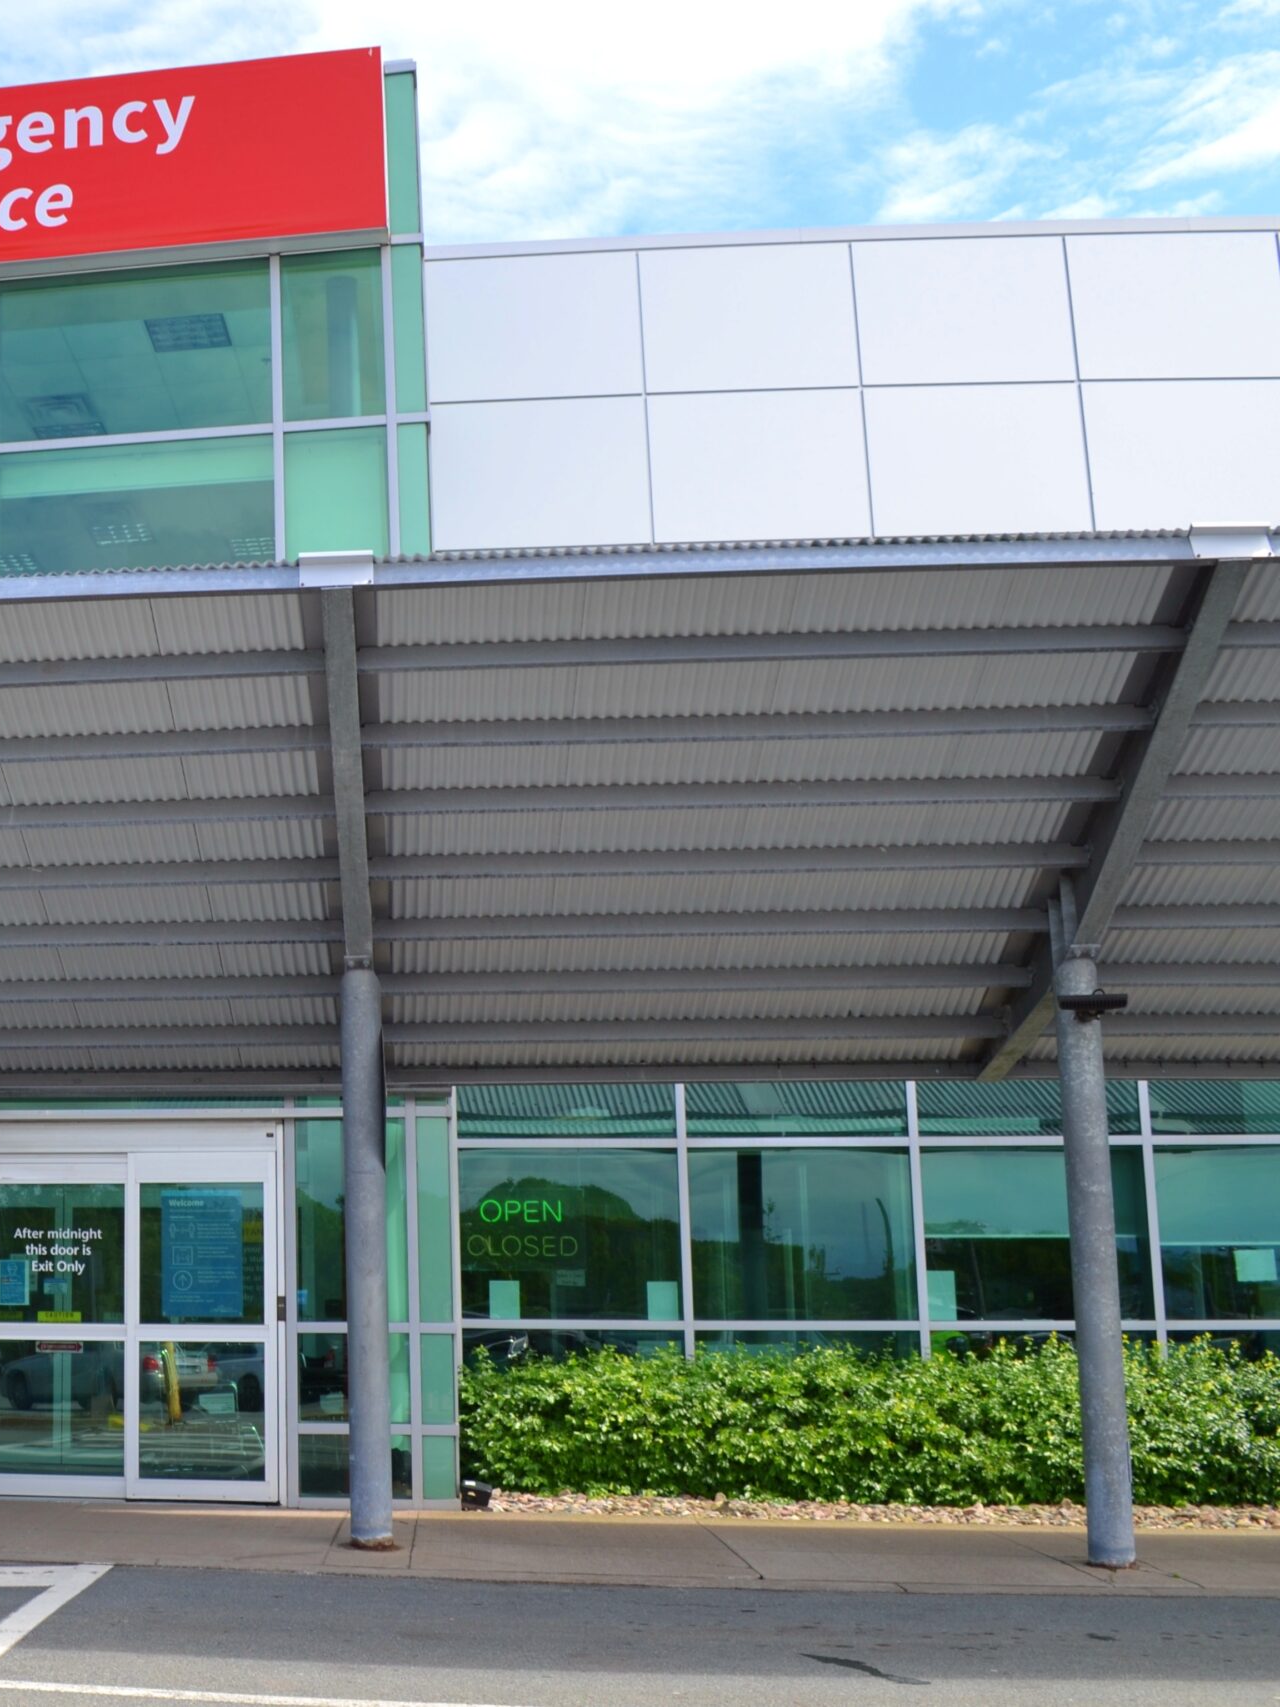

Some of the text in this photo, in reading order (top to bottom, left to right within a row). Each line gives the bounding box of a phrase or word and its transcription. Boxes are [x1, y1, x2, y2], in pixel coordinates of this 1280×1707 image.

[168, 1199, 205, 1207] Welcome
[480, 1199, 563, 1223] OPEN
[13, 1227, 103, 1243] After midnight
[25, 1243, 92, 1256] this door is
[466, 1234, 579, 1257] CLOSED
[31, 1260, 86, 1276] Exit Only
